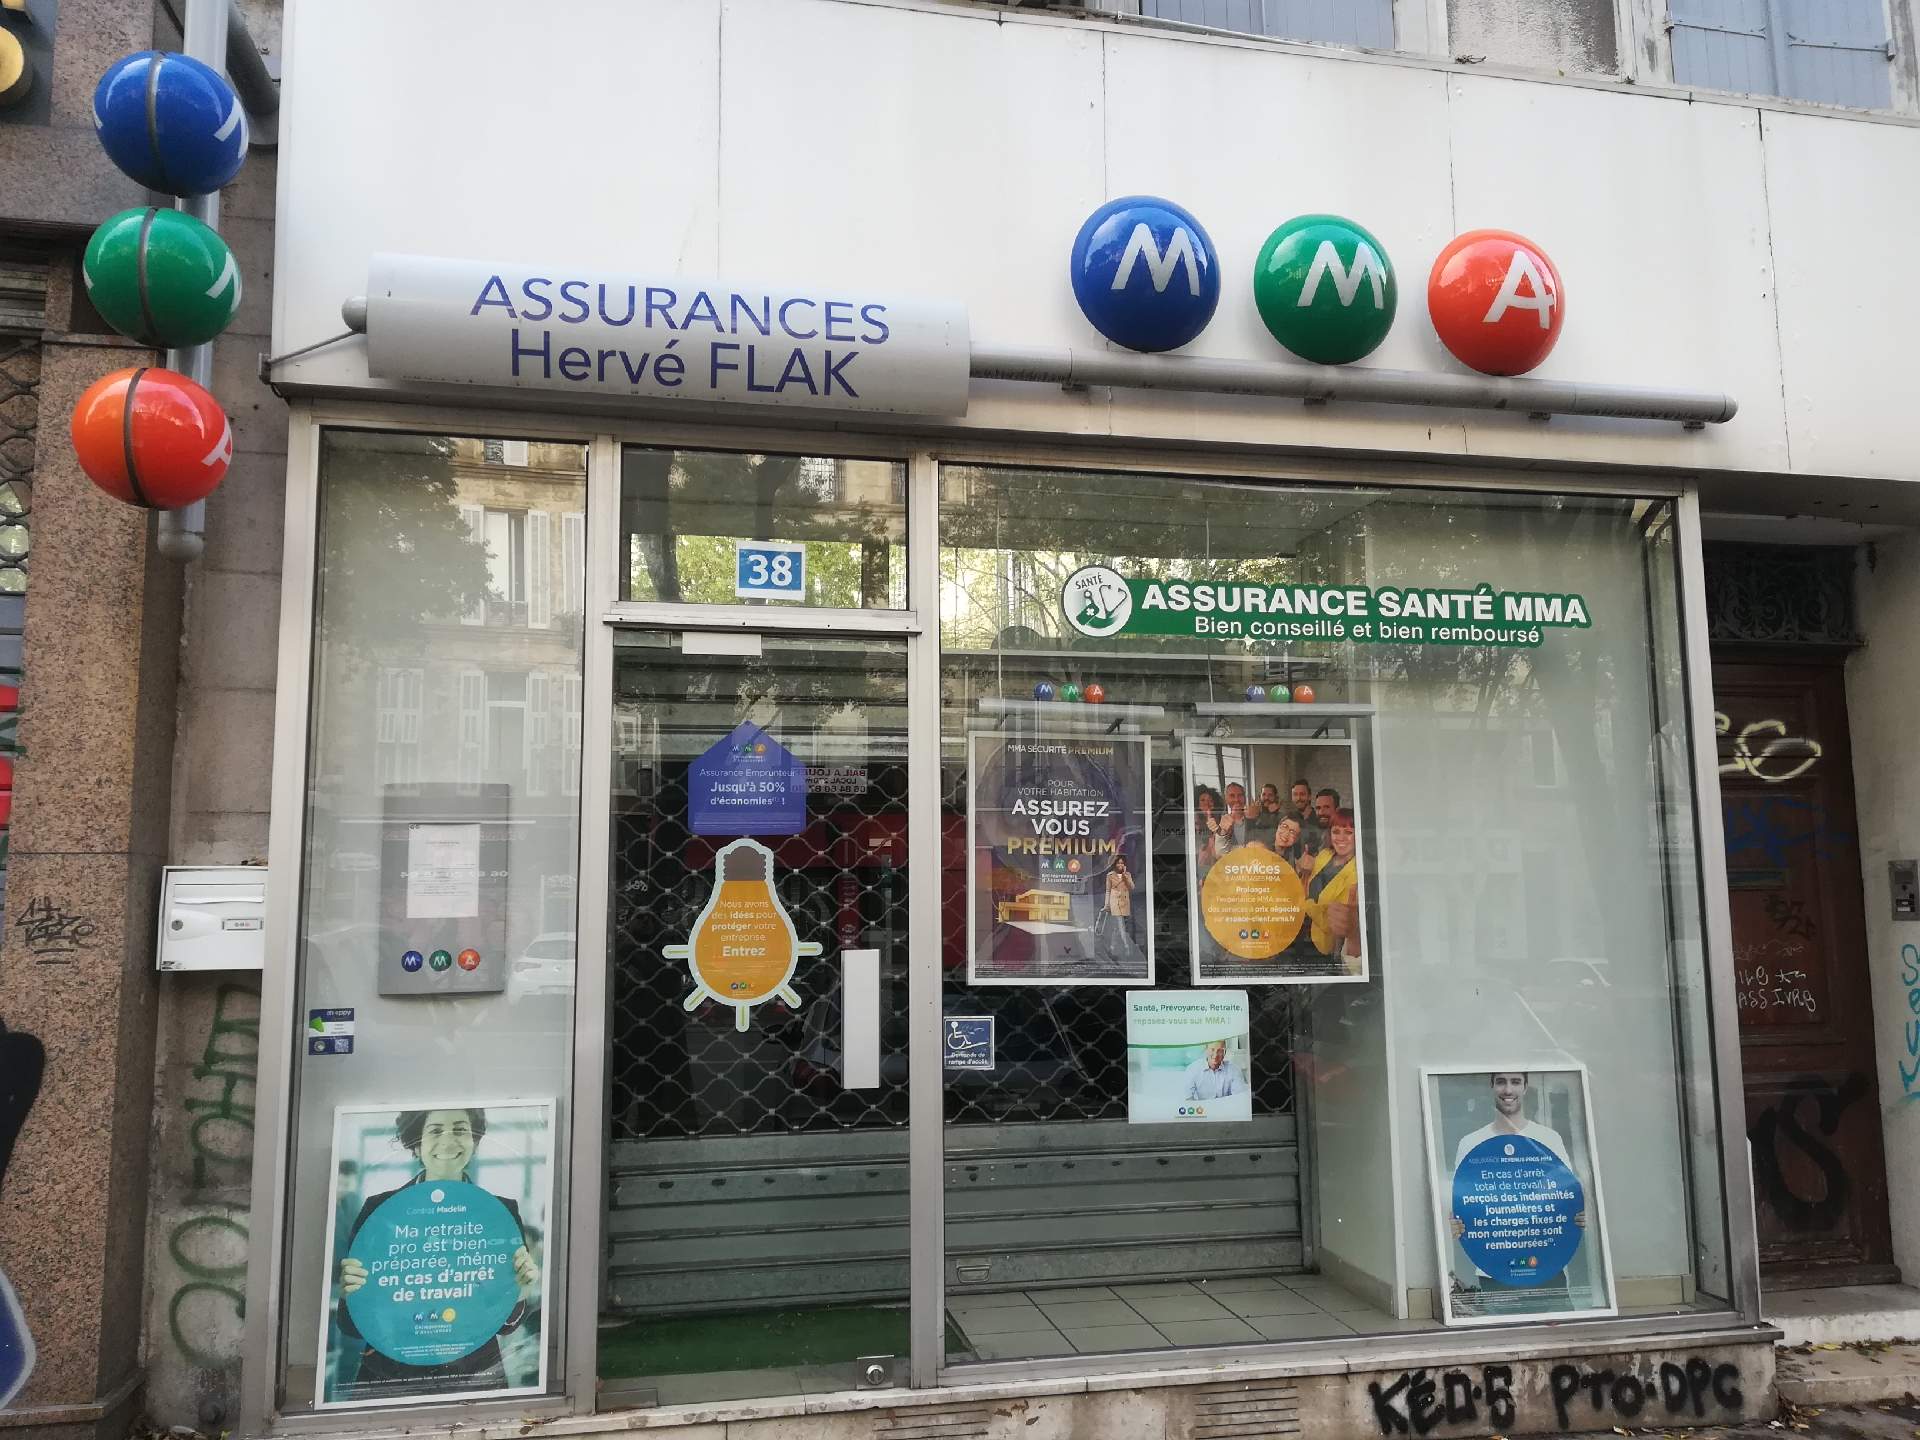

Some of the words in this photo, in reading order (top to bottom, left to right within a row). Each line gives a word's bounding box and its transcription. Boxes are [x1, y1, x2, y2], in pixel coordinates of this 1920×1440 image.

[470, 275, 891, 345] ASSURANCES
[511, 329, 686, 387] Hervé
[710, 342, 860, 398] FLAK
[748, 554, 793, 587] 38
[1075, 571, 1103, 590] SANTÉ
[1141, 584, 1368, 616] ASSURANCE
[1378, 588, 1494, 620] SANTÉ
[1504, 596, 1587, 623] MMA
[1195, 616, 1242, 635] Bien
[1250, 619, 1345, 637] conseillé
[1352, 623, 1372, 638] et
[1379, 622, 1423, 639] bien
[1431, 625, 1539, 643] remboursé
[1007, 744, 1025, 753] MMA
[1027, 743, 1067, 754] SÉCURITÉ
[1068, 746, 1114, 755] PREMIUM
[699, 768, 743, 777] Assurance
[745, 769, 795, 779] Emprunteur
[710, 781, 756, 794] Jusqu'à
[759, 782, 785, 793] 50%
[1018, 787, 1047, 796] VOTRE
[1050, 788, 1104, 797] HABITATION
[1011, 799, 1109, 817] ASSUREZ
[1031, 818, 1090, 835] VOUS
[1007, 838, 1116, 855] PREMIUM
[1224, 863, 1281, 875] services
[720, 899, 741, 908] Nous
[730, 911, 754, 919] idées
[711, 922, 751, 932] protéger
[722, 945, 766, 957] Entrez
[1205, 1017, 1226, 1025] MMA
[1481, 1170, 1494, 1179] En
[1496, 1171, 1512, 1179] cas
[1514, 1168, 1545, 1179] d'arrêt
[1474, 1182, 1497, 1192] total
[1499, 1181, 1512, 1190] de
[1547, 1178, 1557, 1190] je
[1462, 1193, 1499, 1205] perçois
[1500, 1193, 1518, 1202] des
[1520, 1190, 1575, 1201] indemnités
[436, 1205, 467, 1214] Madelin
[1485, 1203, 1543, 1216] journalières
[1544, 1203, 1556, 1212] et
[1473, 1217, 1489, 1227] les
[1490, 1216, 1529, 1227] charges
[1531, 1214, 1554, 1225] fixes
[1555, 1214, 1568, 1223] de
[394, 1224, 419, 1238] Ma
[424, 1222, 483, 1237] retraite
[1467, 1230, 1490, 1239] mon
[1492, 1227, 1541, 1239] entreprise
[1542, 1225, 1563, 1236] sont
[388, 1243, 417, 1257] pro
[422, 1239, 447, 1252] est
[452, 1238, 487, 1251] bien
[371, 1254, 452, 1274] préparée,
[456, 1252, 507, 1267] même
[378, 1275, 400, 1287] en
[404, 1273, 433, 1286] cas
[437, 1266, 495, 1283] d'arrêt
[392, 1287, 415, 1302] de
